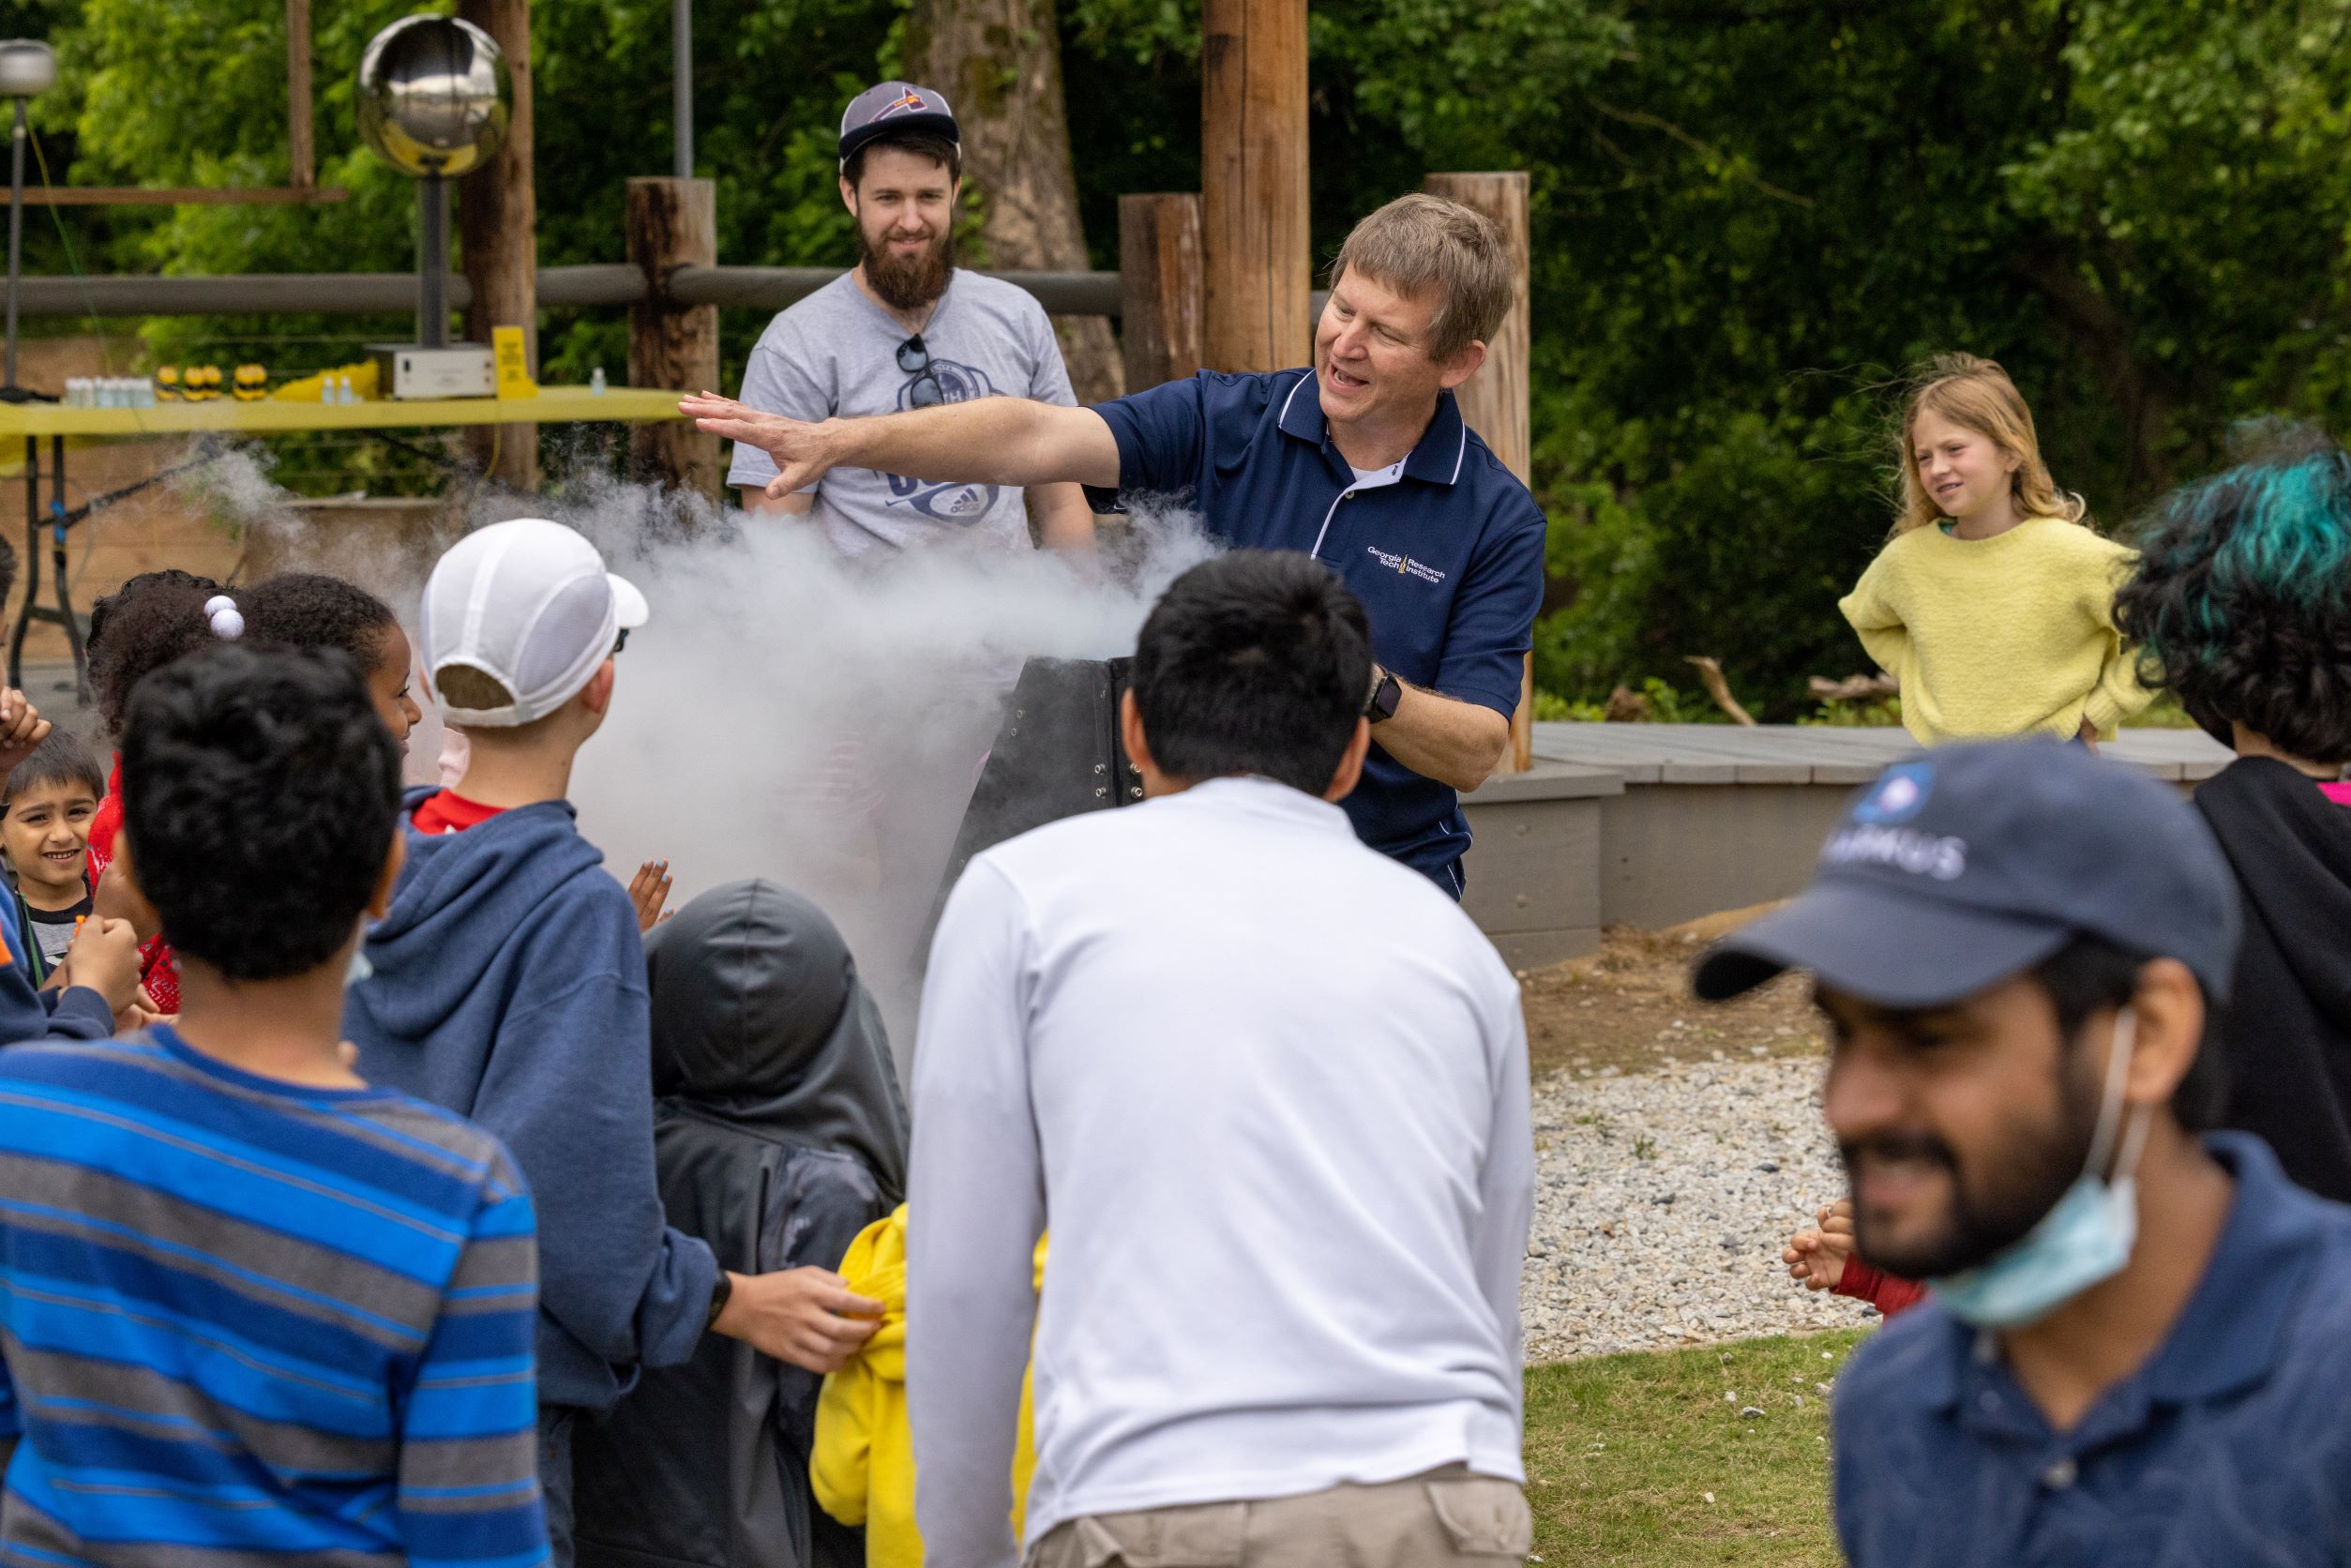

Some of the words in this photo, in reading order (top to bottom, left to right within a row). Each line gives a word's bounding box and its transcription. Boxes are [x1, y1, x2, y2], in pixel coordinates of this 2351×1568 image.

[1367, 546, 1402, 563] Georgia
[1408, 558, 1445, 579] Research
[1379, 557, 1399, 569] Tech
[1406, 565, 1439, 583] Institute
